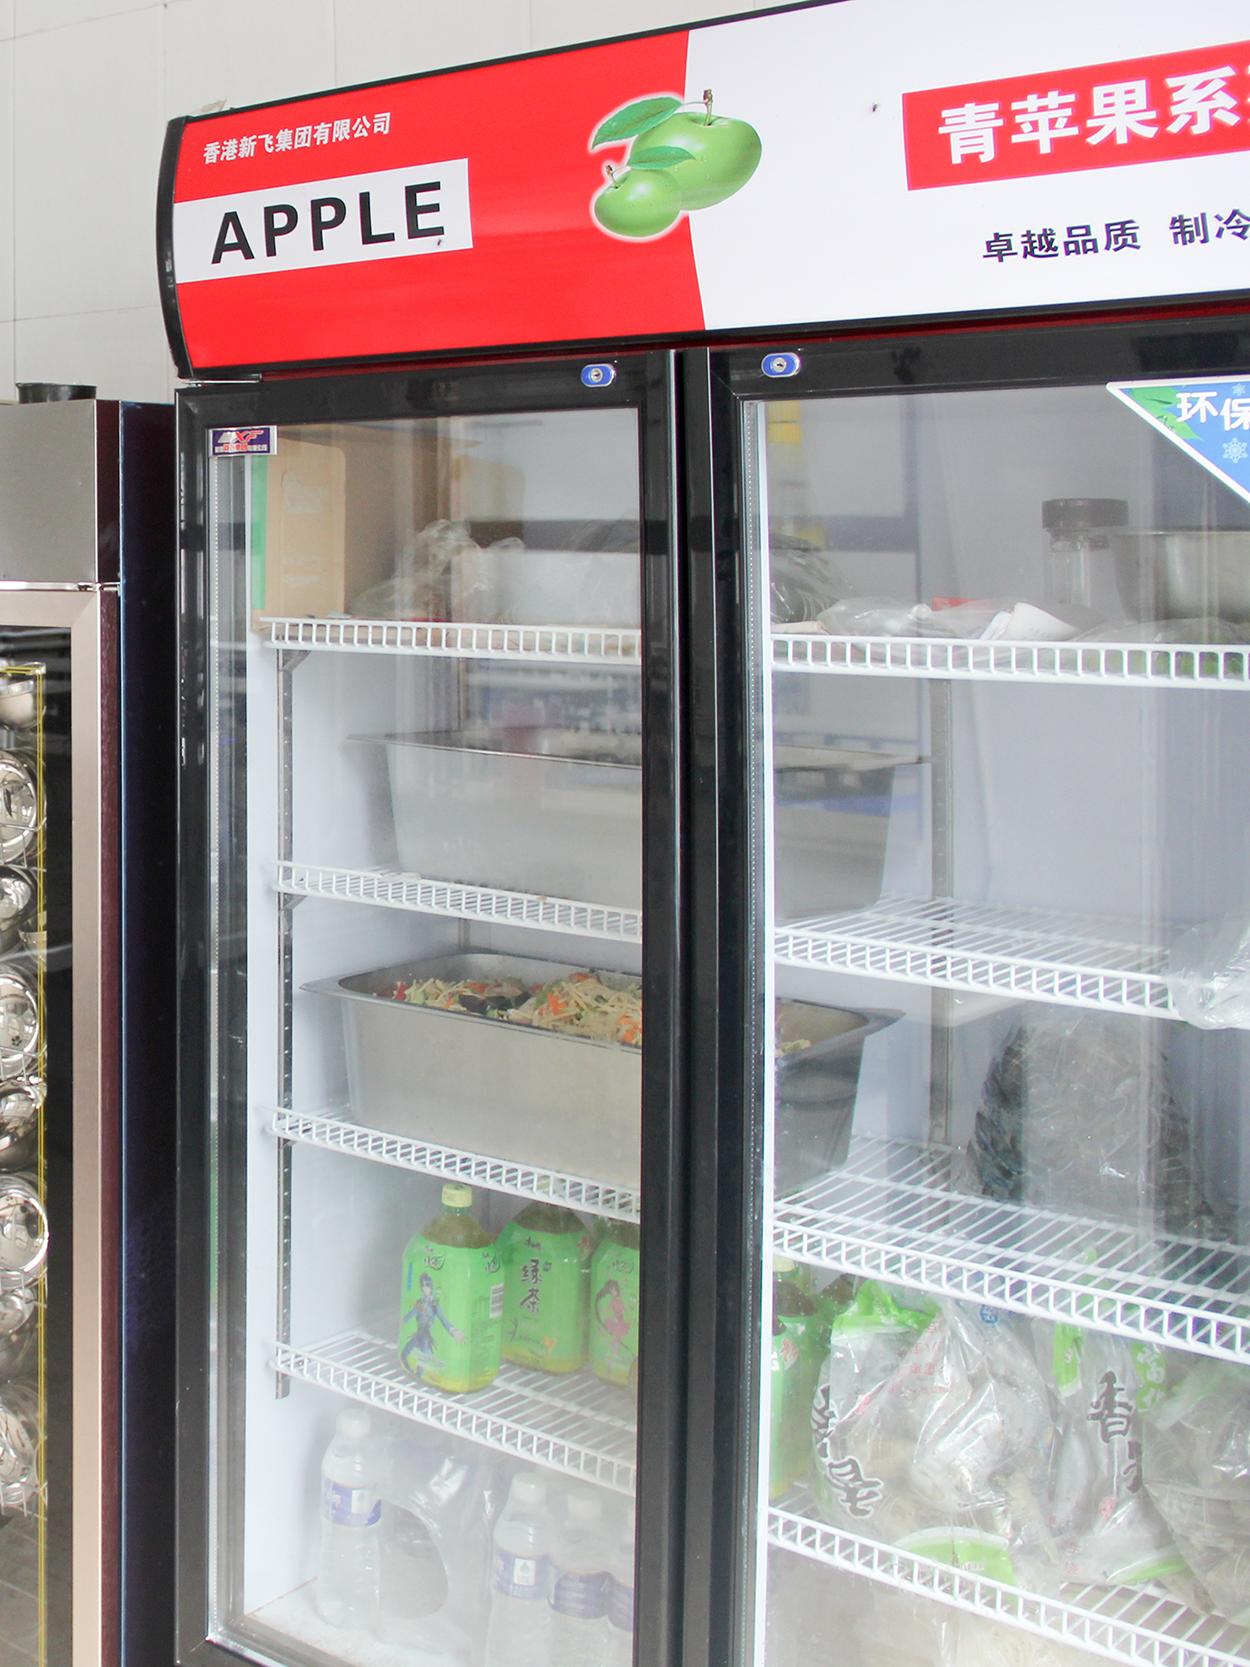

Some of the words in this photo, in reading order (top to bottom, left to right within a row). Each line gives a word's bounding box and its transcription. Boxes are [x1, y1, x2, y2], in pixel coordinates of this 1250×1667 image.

[203, 112, 392, 164] 香港新飞集团有限公司
[938, 65, 1250, 165] 青苹果系
[211, 180, 445, 265] APPLE
[982, 219, 1142, 263] 卓越品质
[1176, 391, 1250, 431] 环保
[520, 1258, 543, 1315] 绿茶
